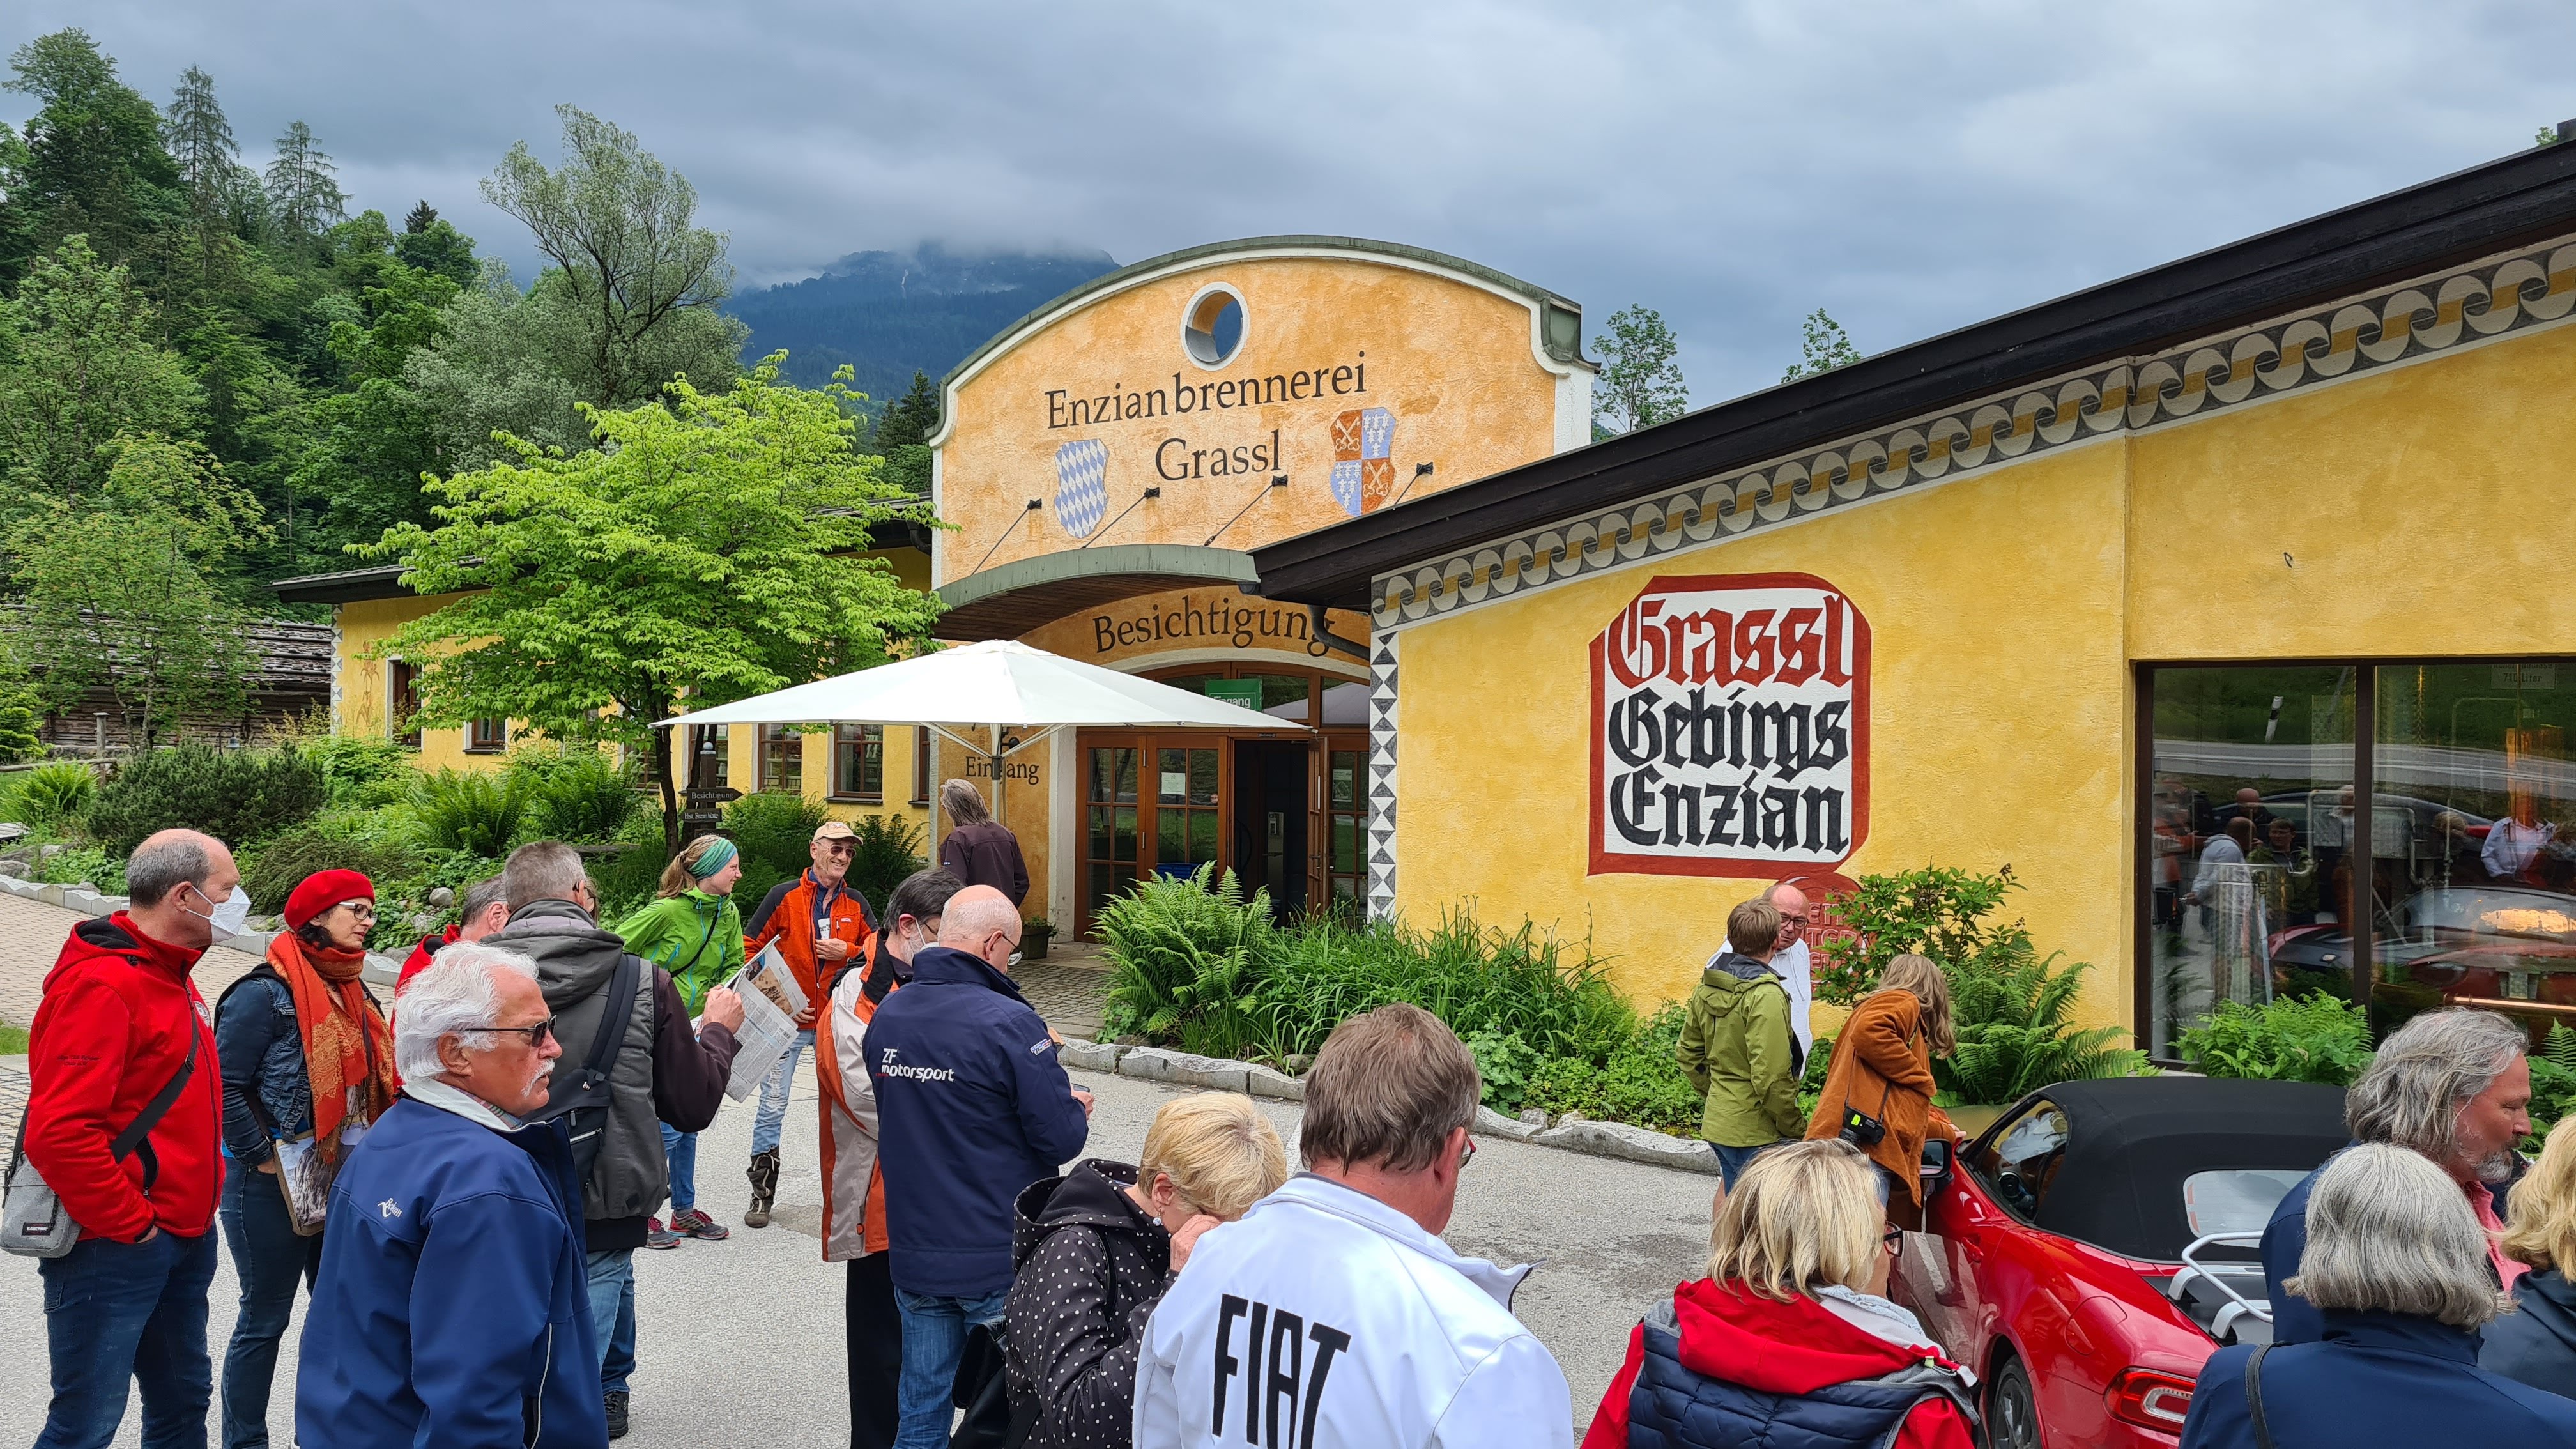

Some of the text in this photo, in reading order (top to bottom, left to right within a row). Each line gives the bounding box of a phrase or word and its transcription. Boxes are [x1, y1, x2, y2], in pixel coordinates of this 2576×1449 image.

[1044, 351, 1367, 429] Enzianbrennerei
[1155, 429, 1282, 482] Grassl
[1607, 594, 1853, 689] Grassl
[965, 756, 1039, 785] Einang
[1608, 685, 1851, 783] Gebirgs
[1609, 763, 1850, 855] Enzian
[881, 1064, 954, 1083] motorsport
[882, 1048, 898, 1064] ZF
[1212, 1293, 1352, 1449] FIAT
